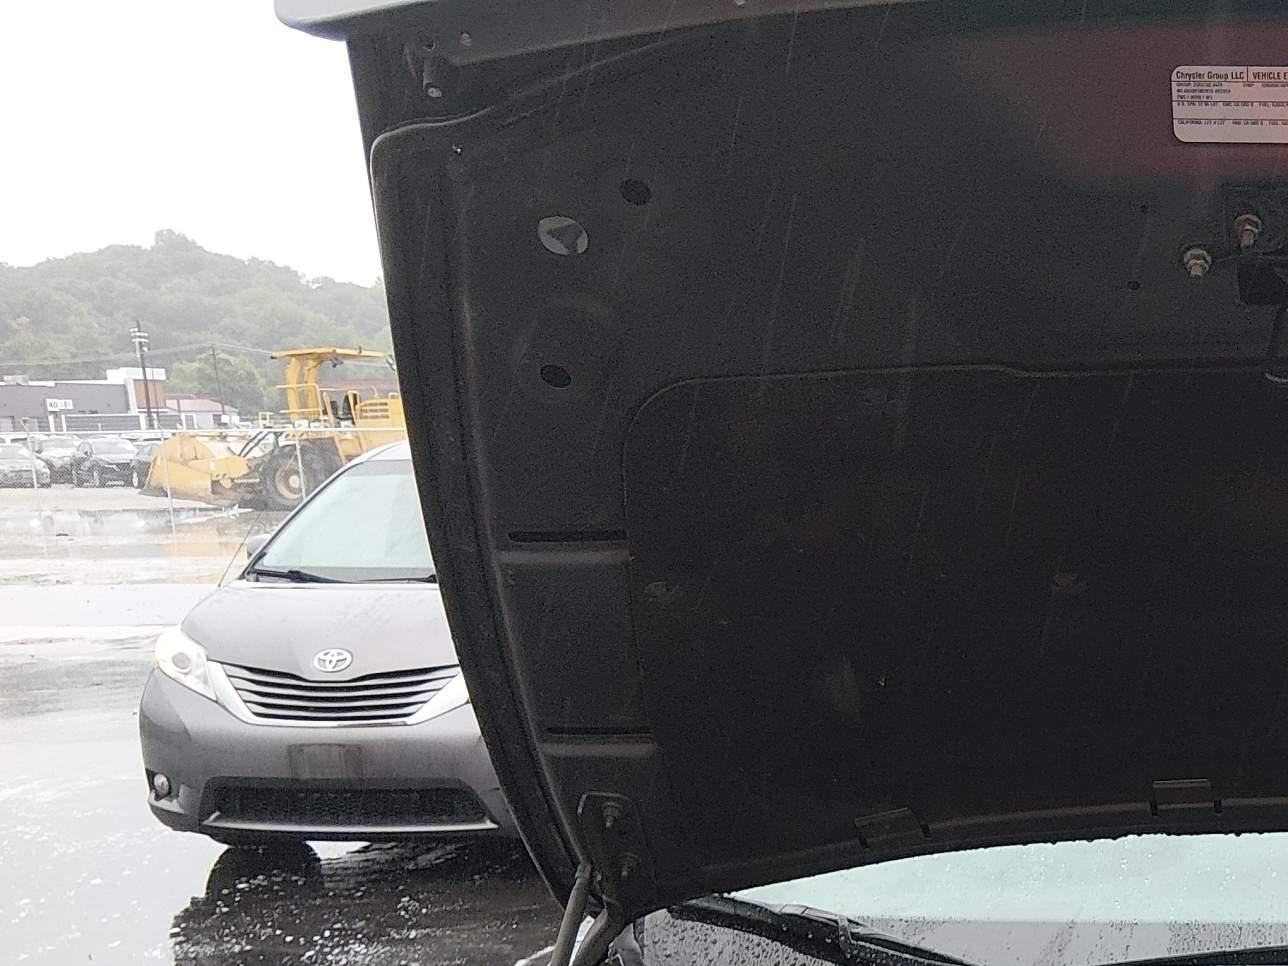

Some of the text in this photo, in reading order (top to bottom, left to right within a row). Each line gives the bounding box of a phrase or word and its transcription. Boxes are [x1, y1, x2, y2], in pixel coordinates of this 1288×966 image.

[1175, 70, 1245, 81] Chrysler Group LLC
[1252, 71, 1282, 81] VEHICLE
